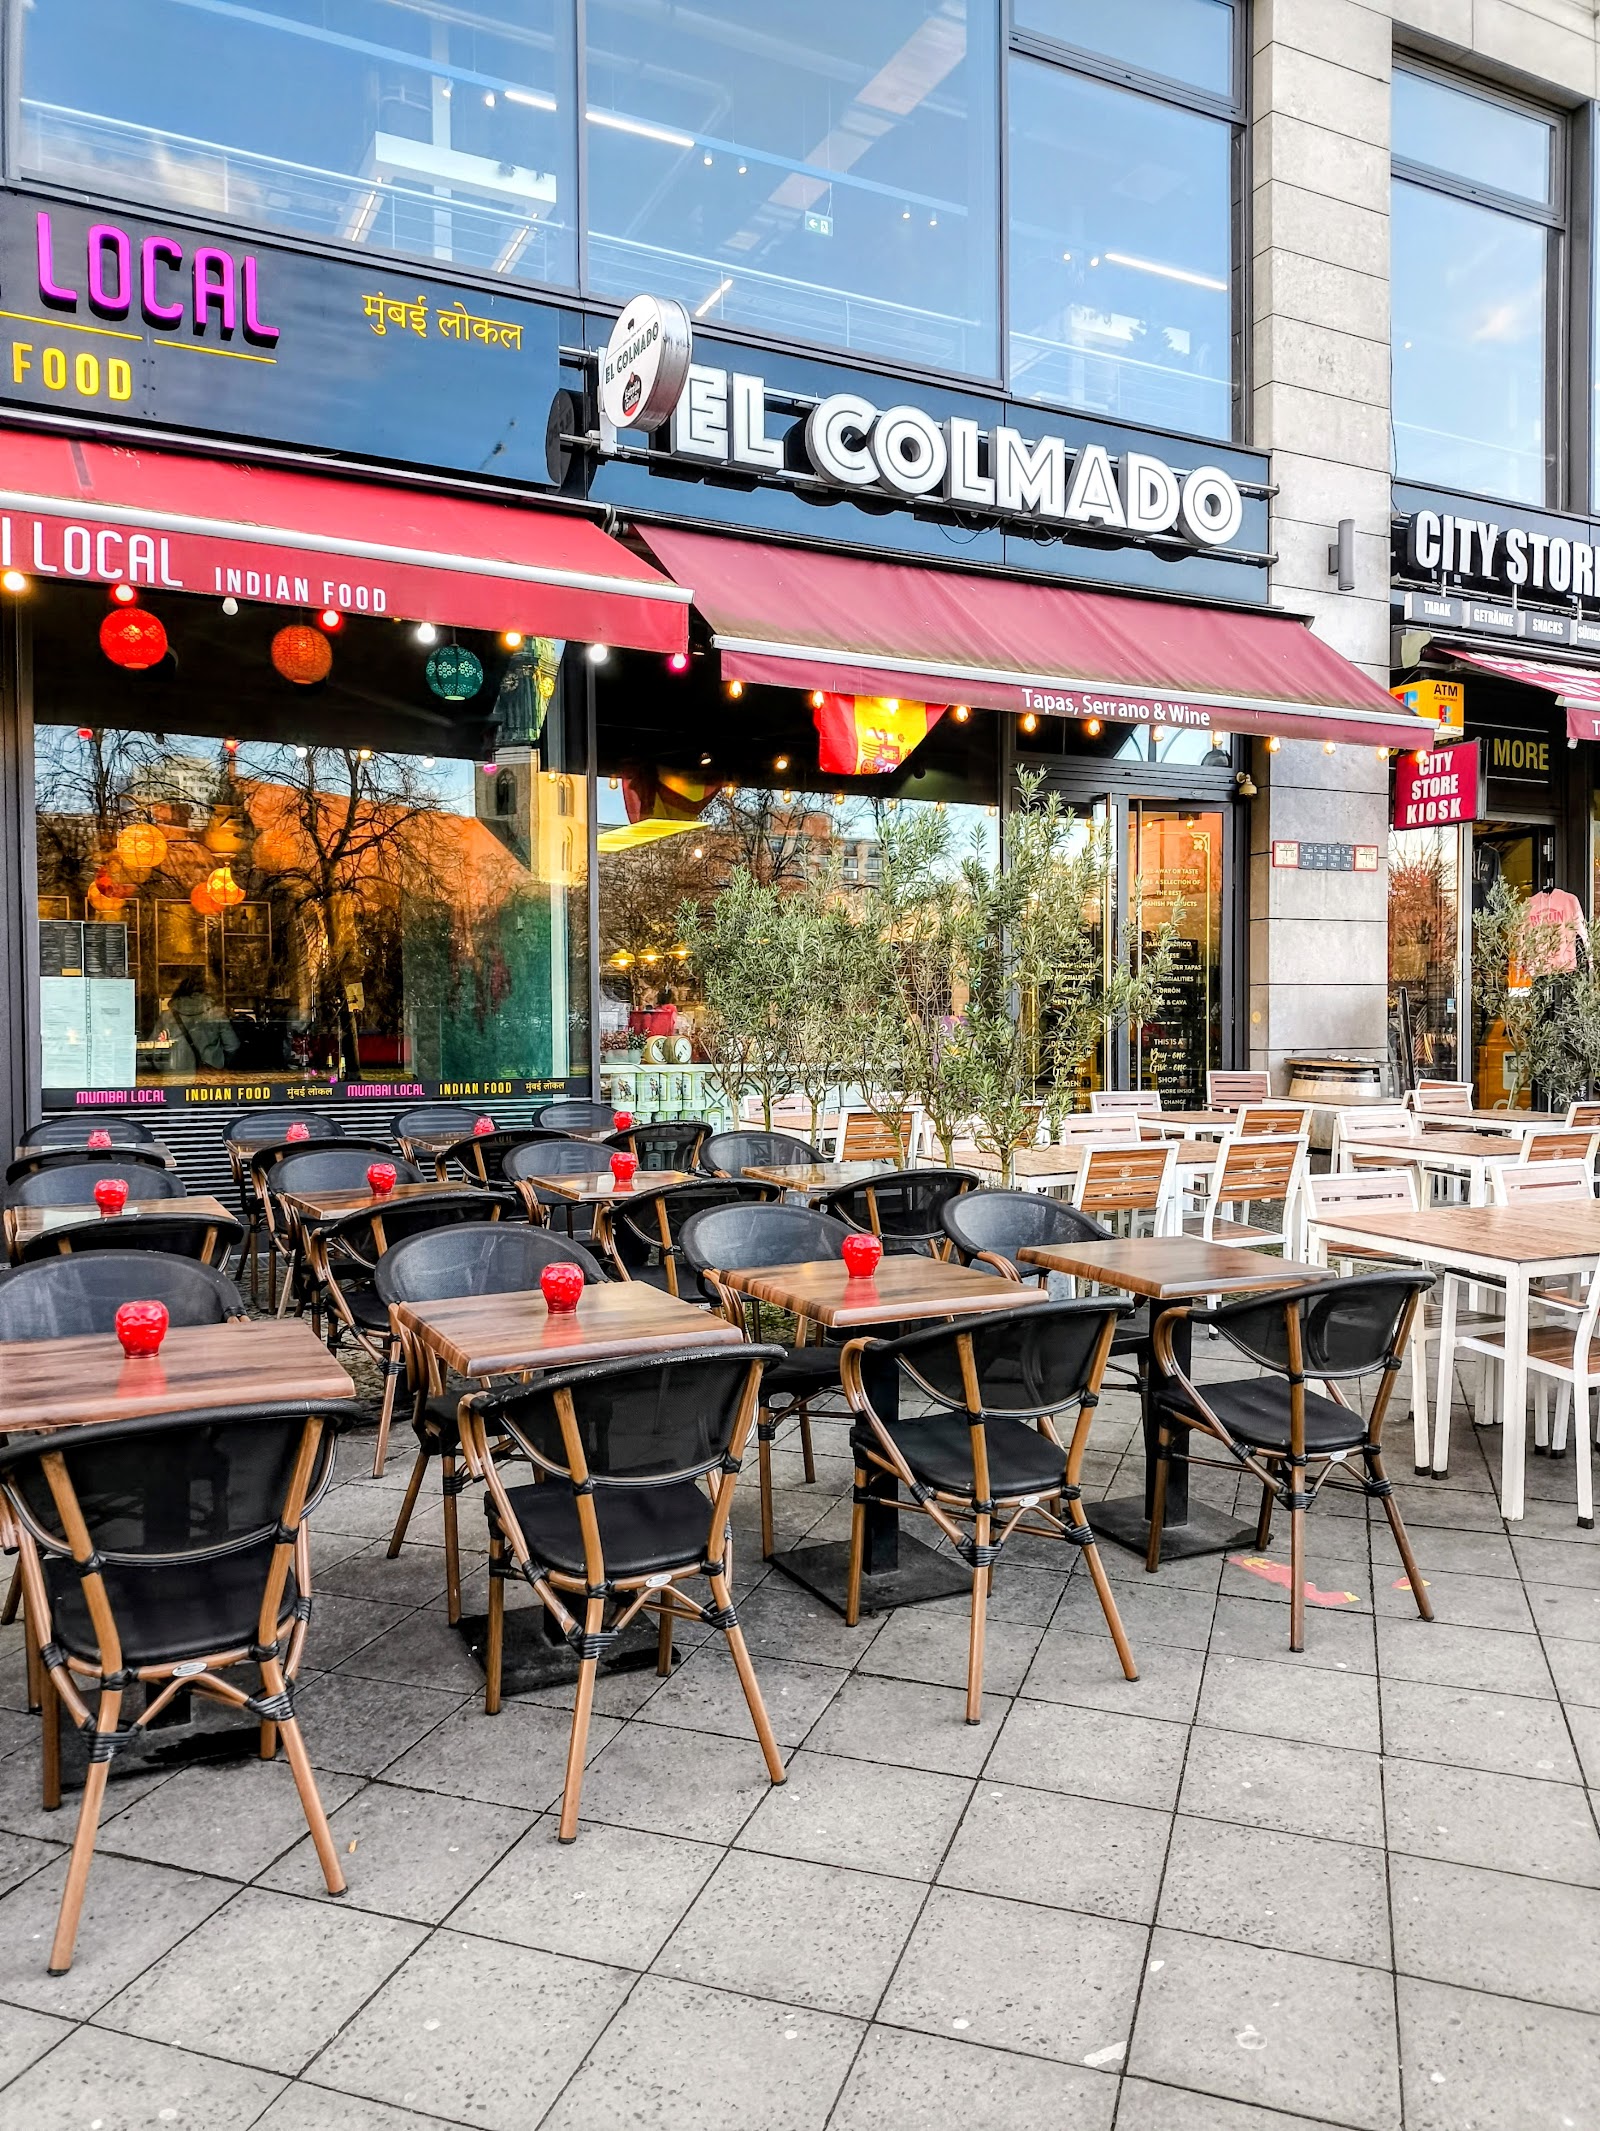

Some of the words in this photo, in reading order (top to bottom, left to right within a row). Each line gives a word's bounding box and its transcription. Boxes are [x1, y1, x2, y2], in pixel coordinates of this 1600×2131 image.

[37, 212, 280, 340] LOCAL
[362, 292, 428, 338] मुंबई
[436, 302, 524, 350] लोकल
[605, 363, 615, 385] EL
[616, 322, 659, 374] COLMADO
[12, 341, 132, 401] FOOD
[675, 363, 784, 470] EL
[810, 392, 1243, 547] COLMADO
[1414, 510, 1498, 577] CITY
[33, 521, 183, 587] LOCAL
[215, 566, 309, 603] INDIAN
[323, 581, 386, 612] FOOD
[1424, 600, 1451, 617] TABAK
[1473, 608, 1513, 627] GETRÄNKE
[1532, 618, 1563, 636] SNACKS
[1434, 684, 1458, 697] ATM
[1022, 689, 1079, 715] Tapas,
[1083, 695, 1149, 720] Serrano
[1153, 702, 1166, 721] &
[1168, 704, 1210, 725] Wine
[1418, 751, 1453, 776] CITY
[1494, 738, 1549, 770] MORE
[1411, 774, 1458, 800] STORE
[1406, 798, 1461, 824] KIOSK
[76, 1090, 127, 1104] MUMBAI
[130, 1089, 167, 1103] LOCAL
[185, 1088, 232, 1101] INDIAN
[237, 1087, 271, 1100] FOOD
[307, 1086, 333, 1097] लोकल
[347, 1084, 391, 1097] MUMBAI
[394, 1083, 425, 1096] LOCAL
[439, 1082, 479, 1095] INDIAN
[484, 1081, 512, 1094] FOOD
